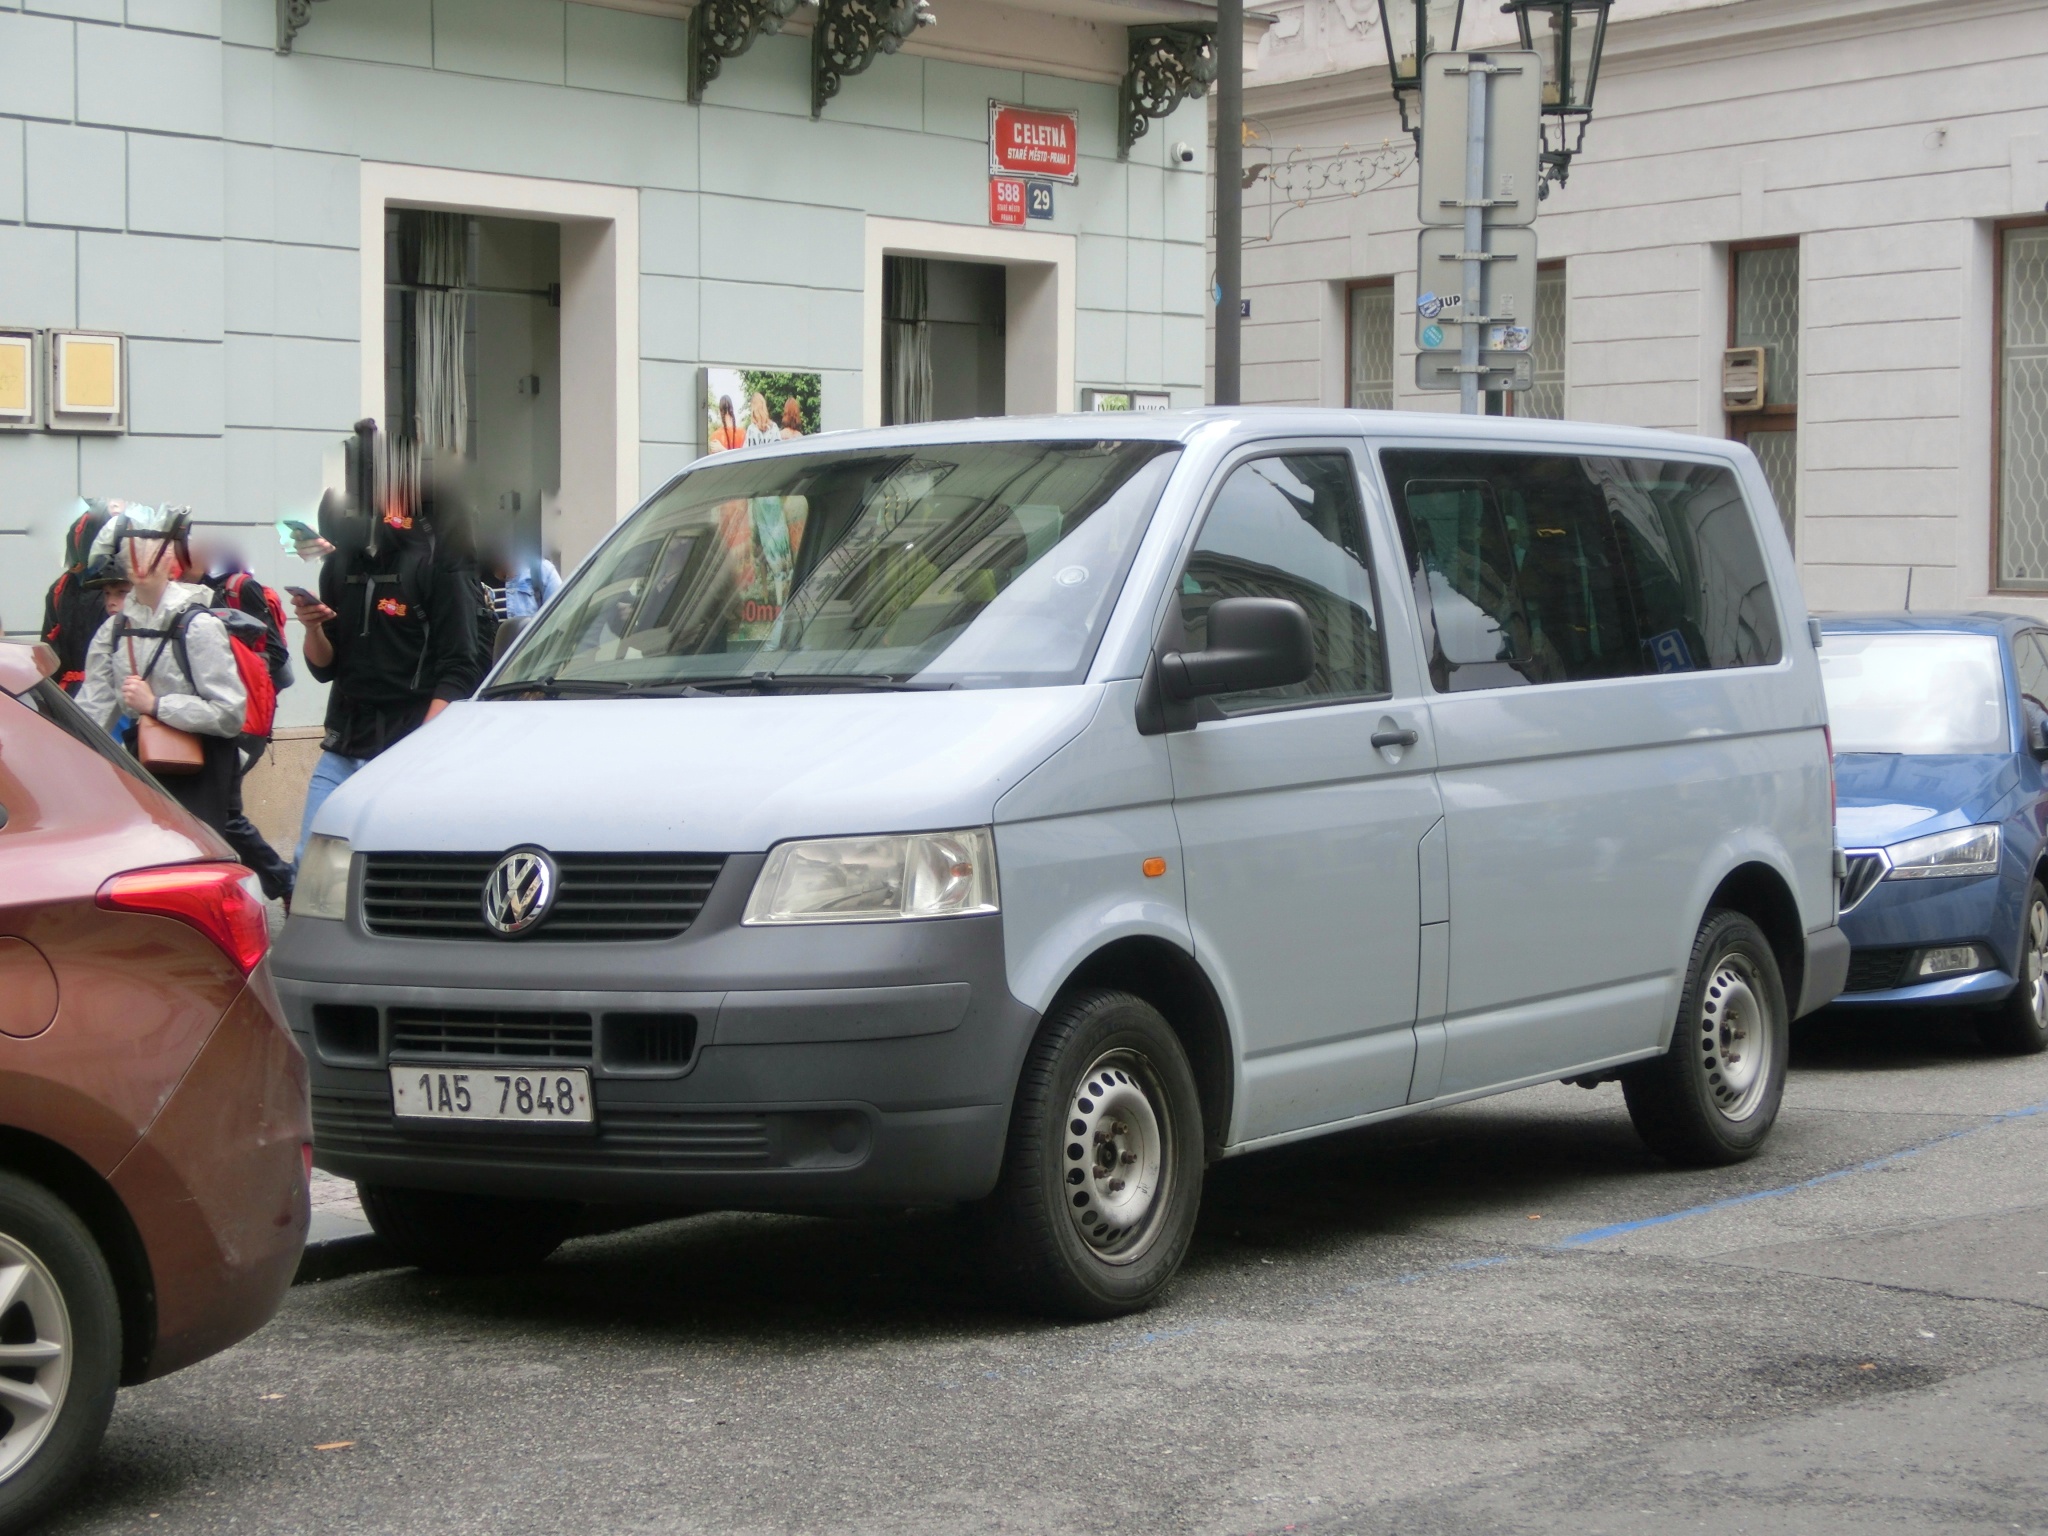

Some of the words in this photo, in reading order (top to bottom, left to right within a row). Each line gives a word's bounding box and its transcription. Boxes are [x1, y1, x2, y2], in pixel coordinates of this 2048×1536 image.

[1013, 122, 1067, 149] CELETNÁ
[1007, 146, 1028, 160] STARÉ
[997, 182, 1020, 203] 588
[1033, 189, 1050, 210] 29
[1000, 213, 1014, 222] PRAHA
[419, 1073, 472, 1112] 1A5
[494, 1075, 575, 1116] 7848
